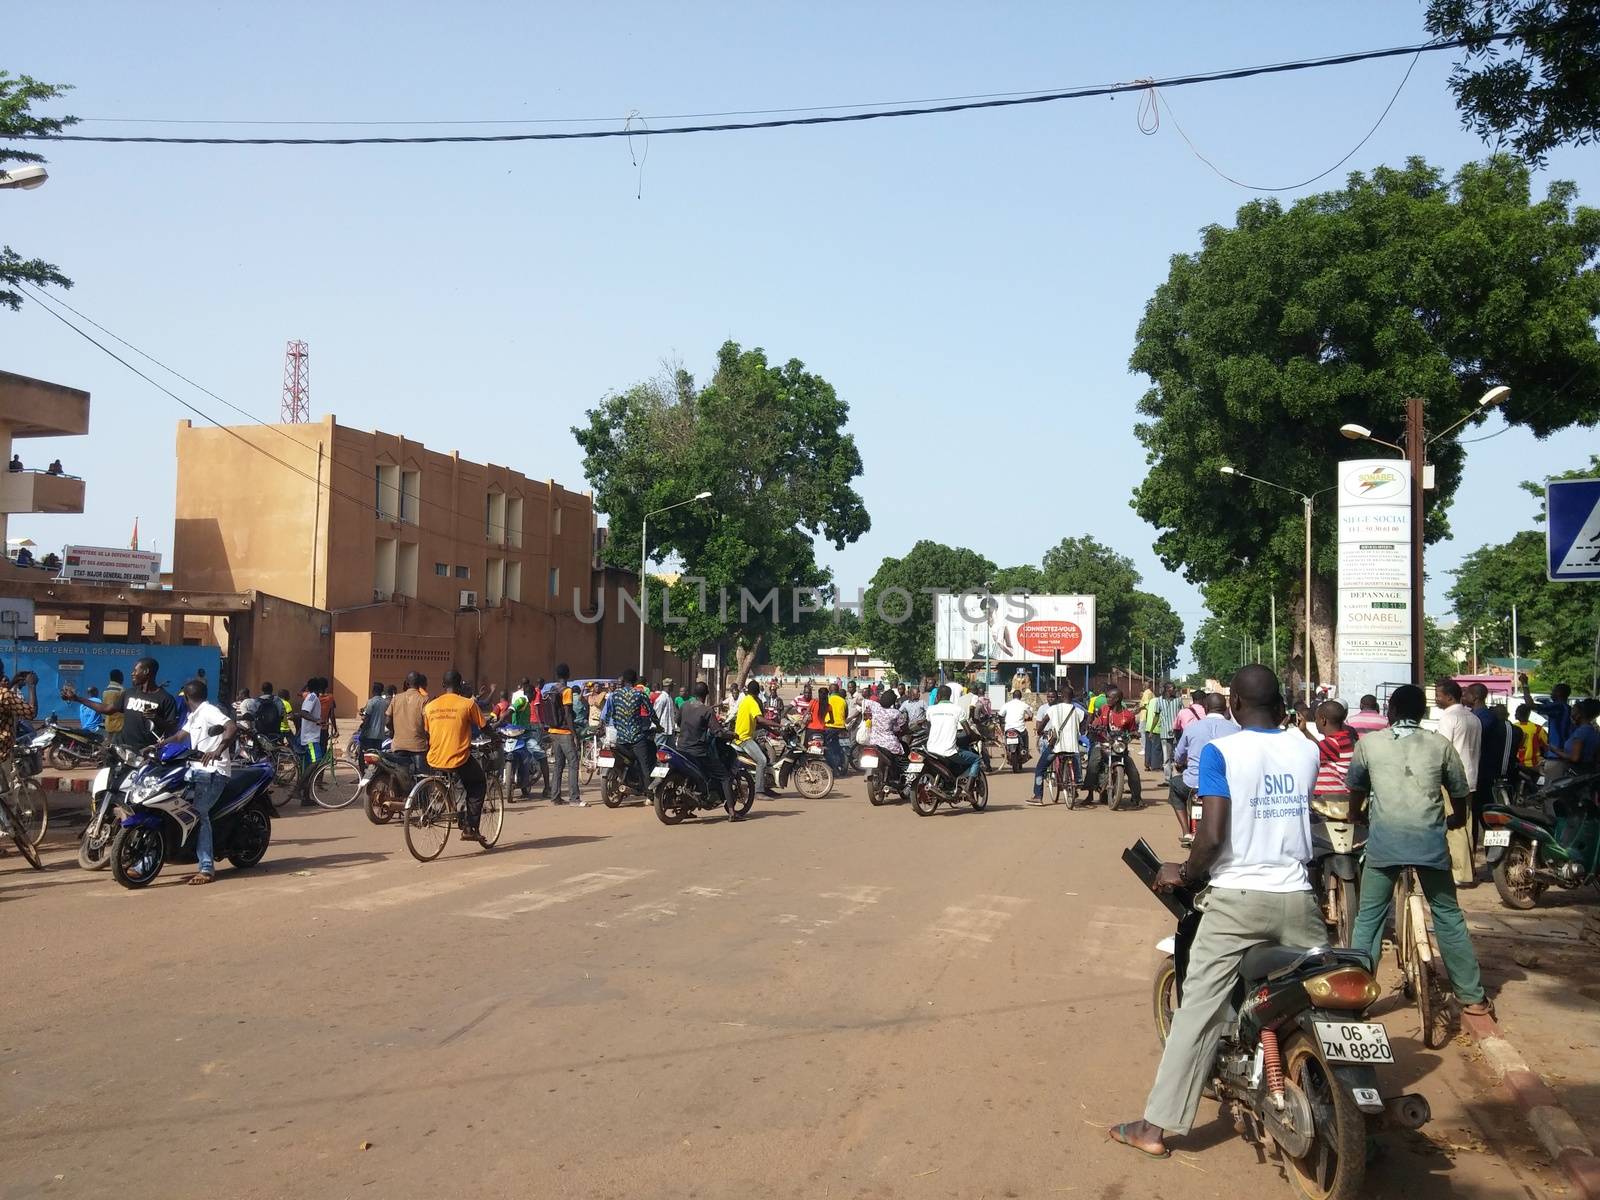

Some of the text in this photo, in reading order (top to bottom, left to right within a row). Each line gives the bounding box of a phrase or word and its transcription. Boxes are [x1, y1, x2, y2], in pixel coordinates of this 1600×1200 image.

[110, 648, 142, 656] ARMEES
[1264, 774, 1294, 795] SND
[1250, 796, 1270, 807] SERVICE
[1271, 796, 1300, 804] NATIONAL
[1254, 807, 1307, 819] LE DEVELOPPEMNT
[1341, 1026, 1362, 1040] 06
[1323, 1042, 1391, 1059] ZM 8820
